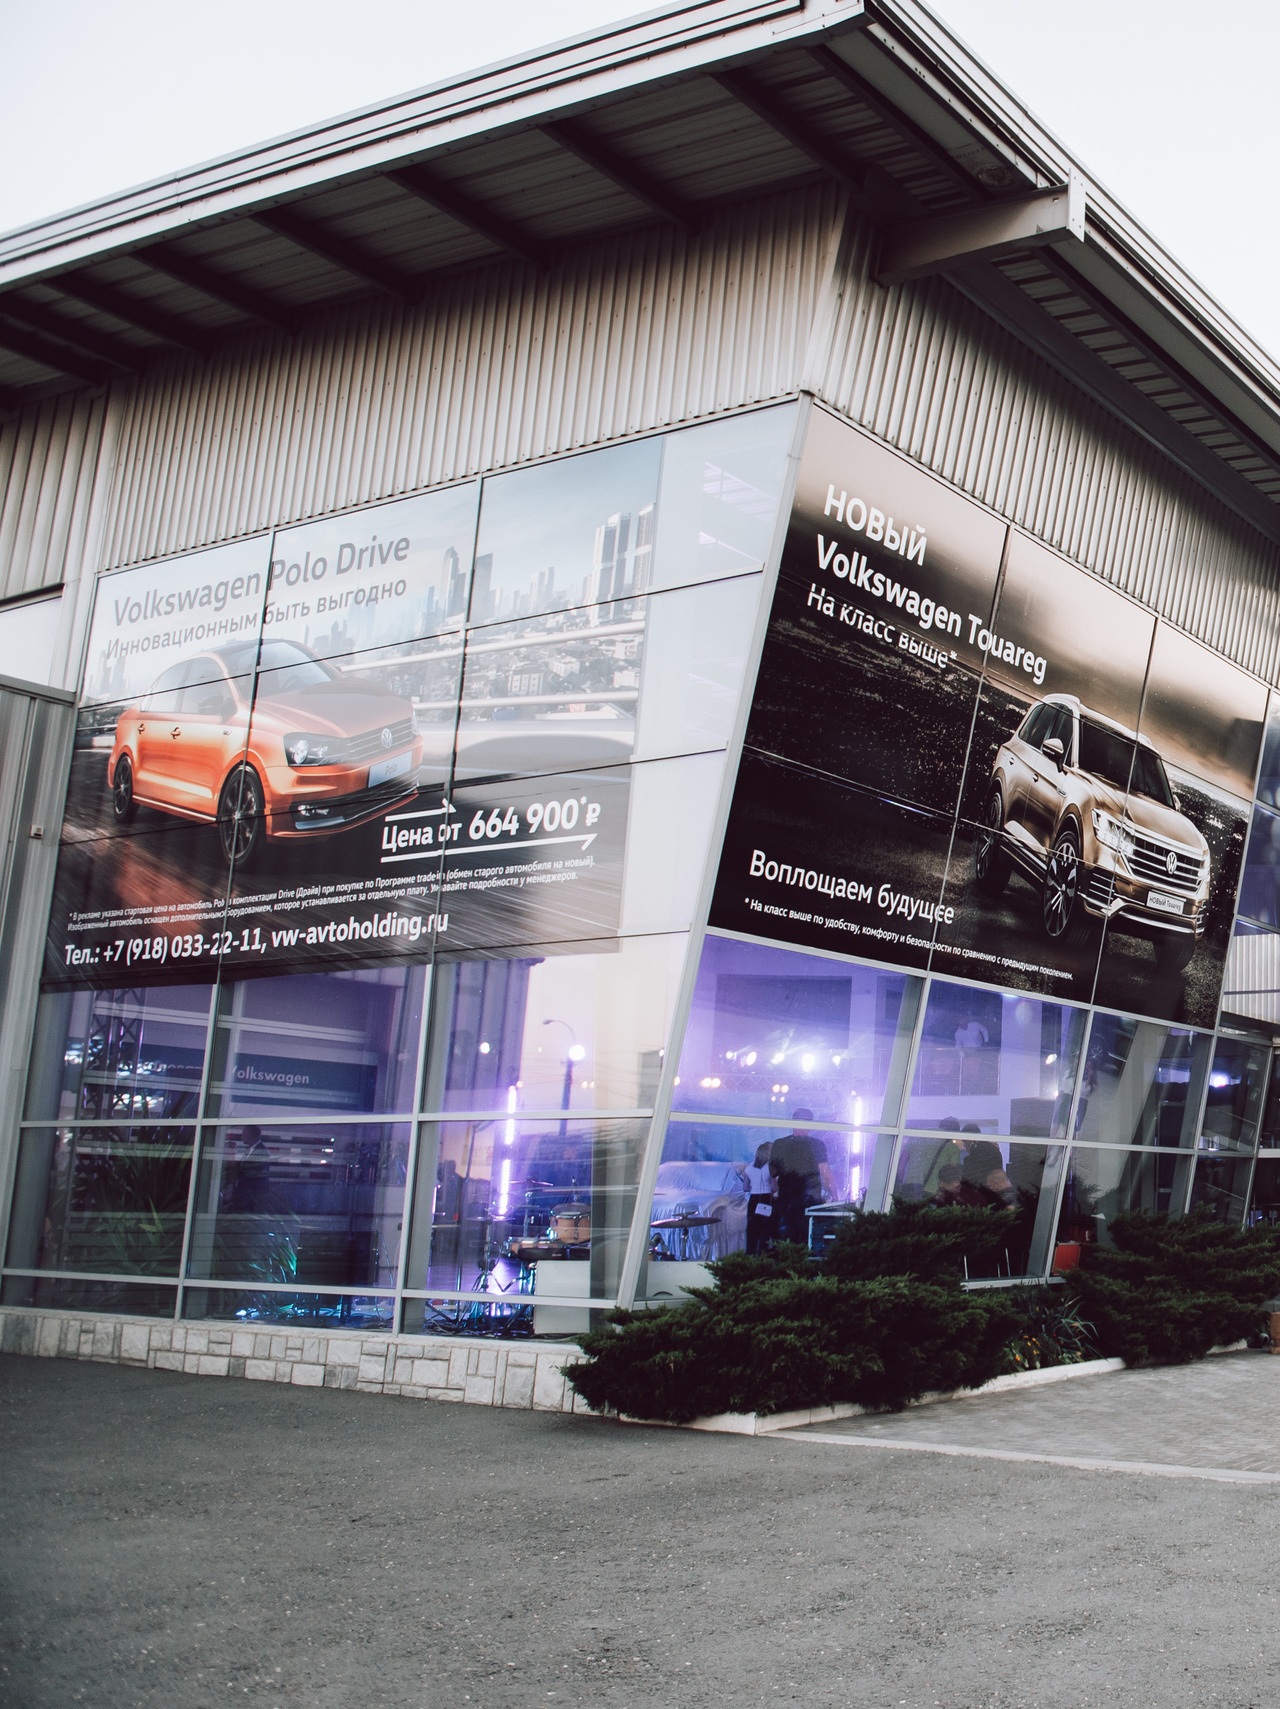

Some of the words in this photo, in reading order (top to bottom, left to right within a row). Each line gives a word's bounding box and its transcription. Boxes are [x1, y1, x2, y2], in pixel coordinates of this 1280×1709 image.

[824, 483, 928, 566] НОВЫЙ
[114, 571, 261, 626] Volkswagen
[269, 551, 328, 590] Polo
[335, 534, 411, 575] Drive
[807, 583, 836, 618] На
[839, 602, 896, 643] класс
[817, 533, 962, 637] Volkswagen
[968, 613, 1048, 685] Touareg
[106, 613, 258, 660] Инновационным
[264, 599, 311, 625] быть
[316, 579, 408, 613] выгодно
[381, 823, 434, 852] Цена
[438, 821, 462, 842] от
[468, 807, 520, 840] 664
[67, 918, 109, 931] Изображенный
[110, 916, 143, 928] автомобиль
[144, 915, 170, 925] оснащен
[274, 901, 300, 912] которое
[301, 893, 358, 910] устанавливается
[358, 893, 367, 902] за
[367, 887, 407, 901] отдельную
[407, 883, 429, 897] плату.
[468, 875, 518, 891] подробности
[526, 869, 578, 885] менеджеров.
[78, 912, 101, 922] рекламе
[101, 909, 124, 919] указана
[124, 906, 152, 918] стартовая
[154, 905, 168, 914] цена
[177, 900, 212, 912] автомобиль
[233, 891, 277, 905] комплектации
[278, 888, 295, 900] Drive
[296, 884, 321, 899] (Драйв)
[322, 885, 335, 896] при
[336, 881, 364, 894] покупке
[365, 880, 374, 888] по
[375, 875, 416, 890] Программе
[447, 866, 472, 881] (обмен
[474, 866, 504, 879] старого
[505, 860, 551, 875] автомобиля
[553, 860, 563, 870] на
[564, 855, 596, 868] новый).
[750, 849, 873, 904] Воплощаем
[877, 883, 955, 924] будущее
[65, 944, 100, 965] Тел.:
[103, 940, 124, 962] +7
[126, 936, 167, 966] (918)
[171, 927, 267, 959] 033-22-11,
[271, 911, 449, 948] vw-avtoholding.ru
[764, 903, 788, 918] класс
[789, 908, 812, 922] выше
[813, 914, 823, 924] по
[824, 917, 861, 934] удобству,
[862, 926, 899, 943] комфорту
[952, 946, 961, 955] по
[962, 948, 996, 964] сравнению
[1001, 957, 1039, 973] предыдущим
[1040, 965, 1074, 981] поколением.
